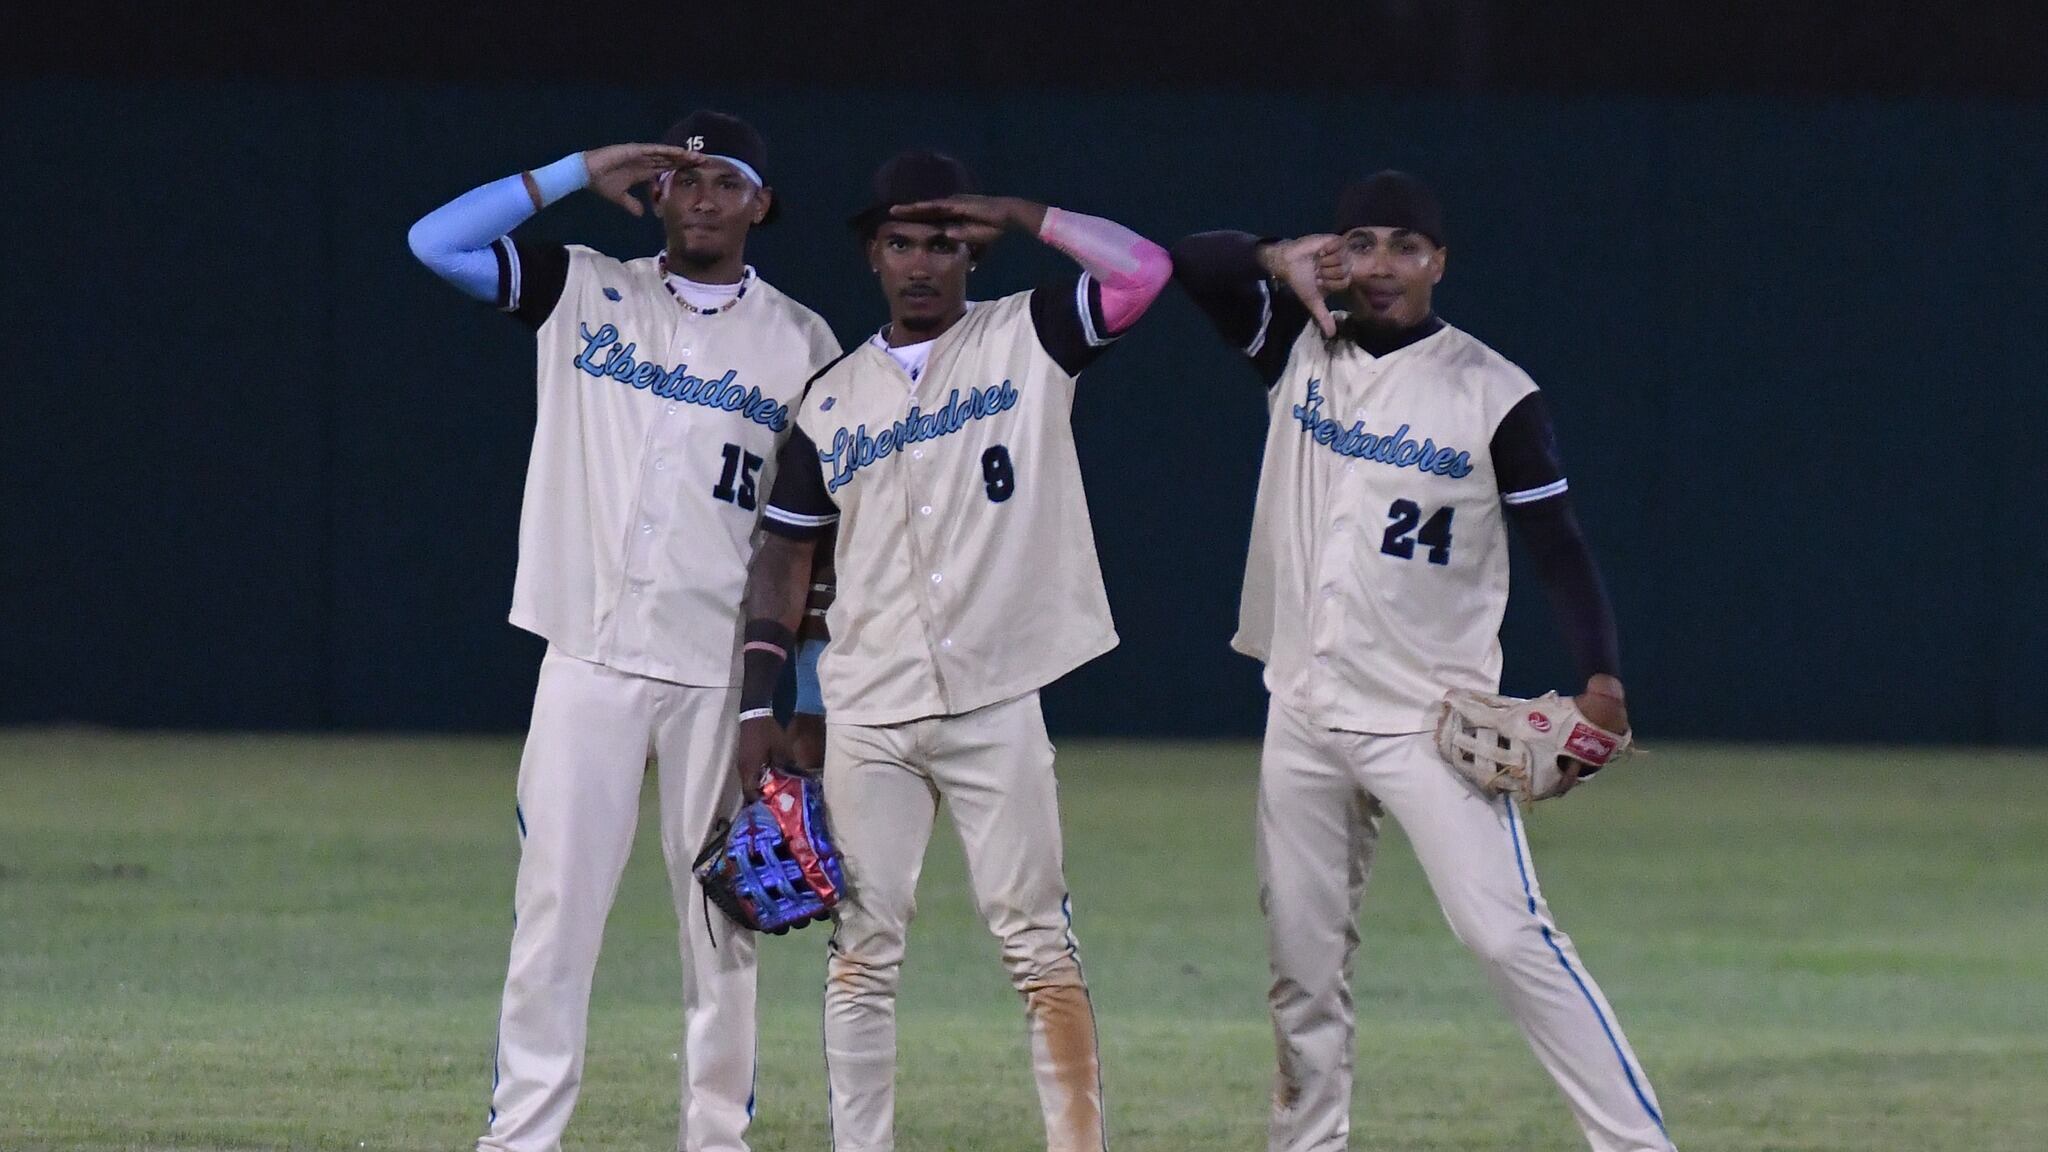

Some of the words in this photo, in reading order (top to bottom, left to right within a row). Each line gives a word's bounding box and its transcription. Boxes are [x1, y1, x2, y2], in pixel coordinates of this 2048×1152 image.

[686, 135, 704, 152] 15
[574, 322, 788, 432] Libertadores
[819, 379, 1018, 493] Libertadores
[1293, 378, 1473, 478] ertadores
[713, 443, 763, 511] 15
[982, 445, 1014, 502] 9
[1381, 499, 1455, 565] 24
